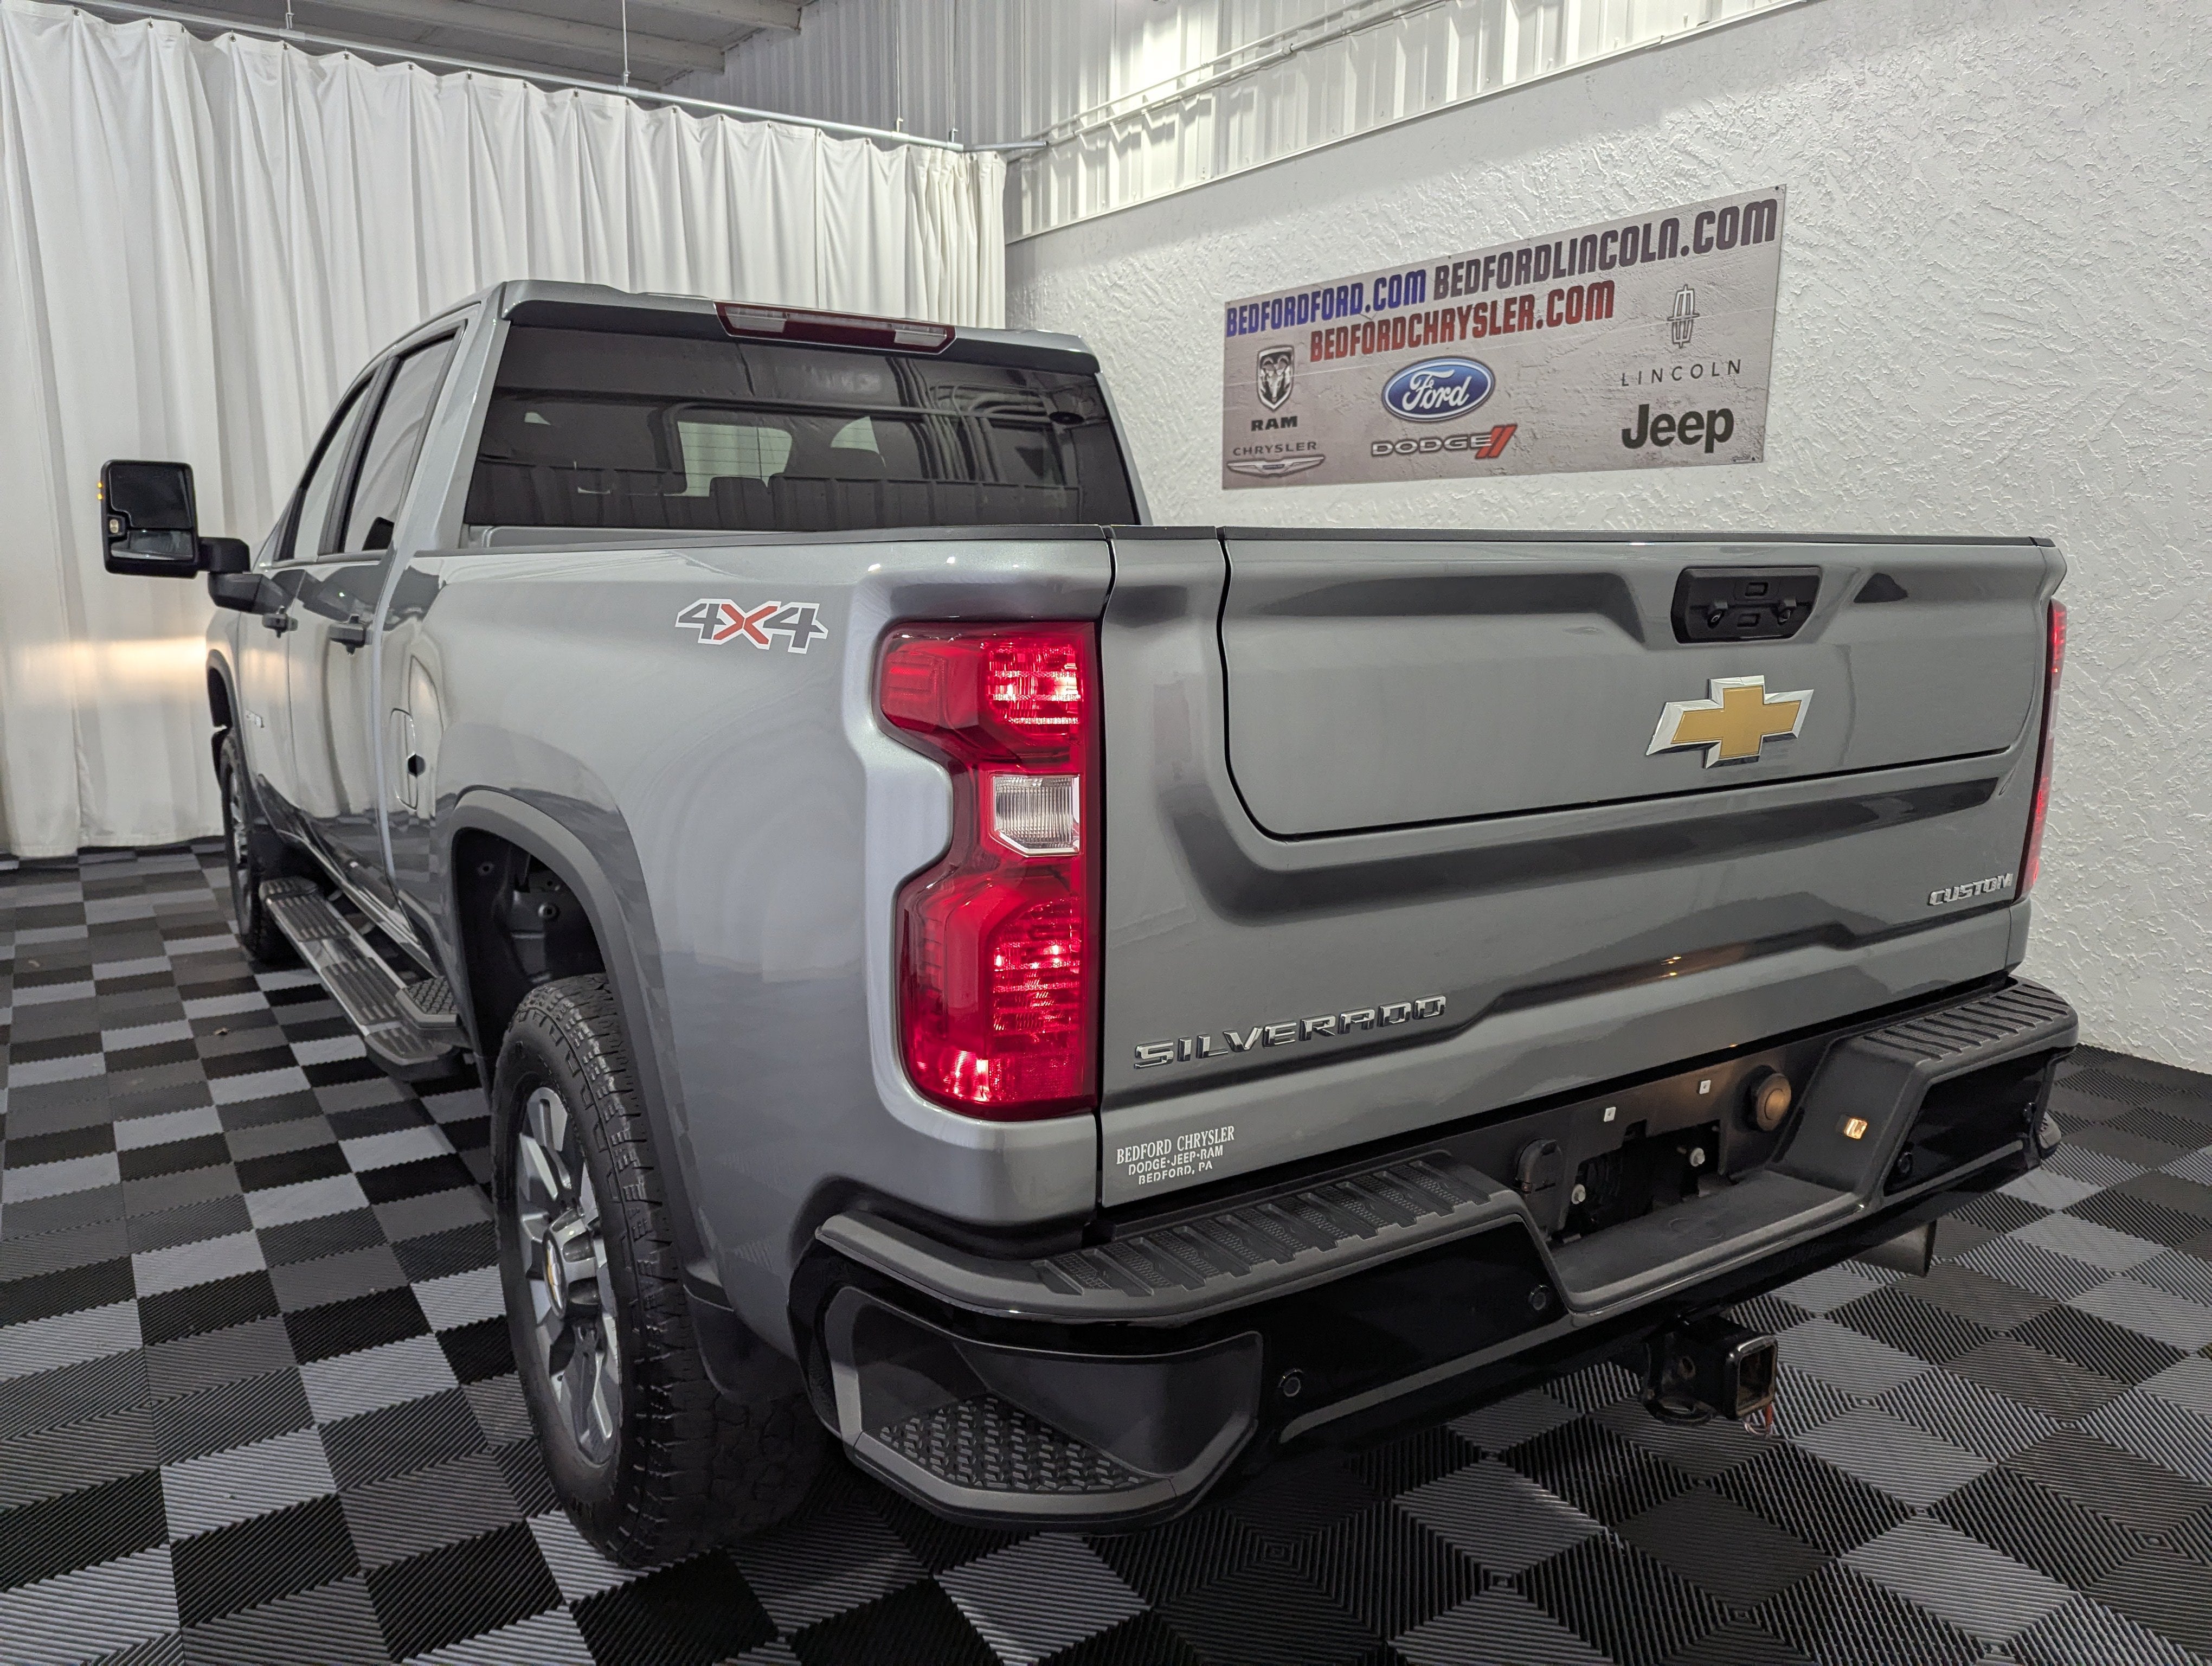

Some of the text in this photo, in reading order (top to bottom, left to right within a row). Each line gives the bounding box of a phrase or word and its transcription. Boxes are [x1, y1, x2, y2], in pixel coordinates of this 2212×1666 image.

[1226, 197, 1777, 337] BEDFORDFORD.COM BEDFORDLINCOLN.COM
[1310, 279, 1614, 362] BEDFORDCHRYSLER.COM
[1402, 369, 1472, 411] Ford
[1622, 359, 1741, 386] LINCOLN
[1251, 415, 1298, 432] RAM
[1622, 403, 1734, 453] Jeep
[1232, 441, 1317, 456] CHRYSLER
[1371, 434, 1493, 457] DODGE
[1927, 872, 2014, 906] CUSTOM
[1134, 995, 1446, 1069] SILVERADO
[1116, 1125, 1235, 1164] BEDFORD CHRYSLER
[1139, 1161, 1213, 1185] BEDFORD, PA
